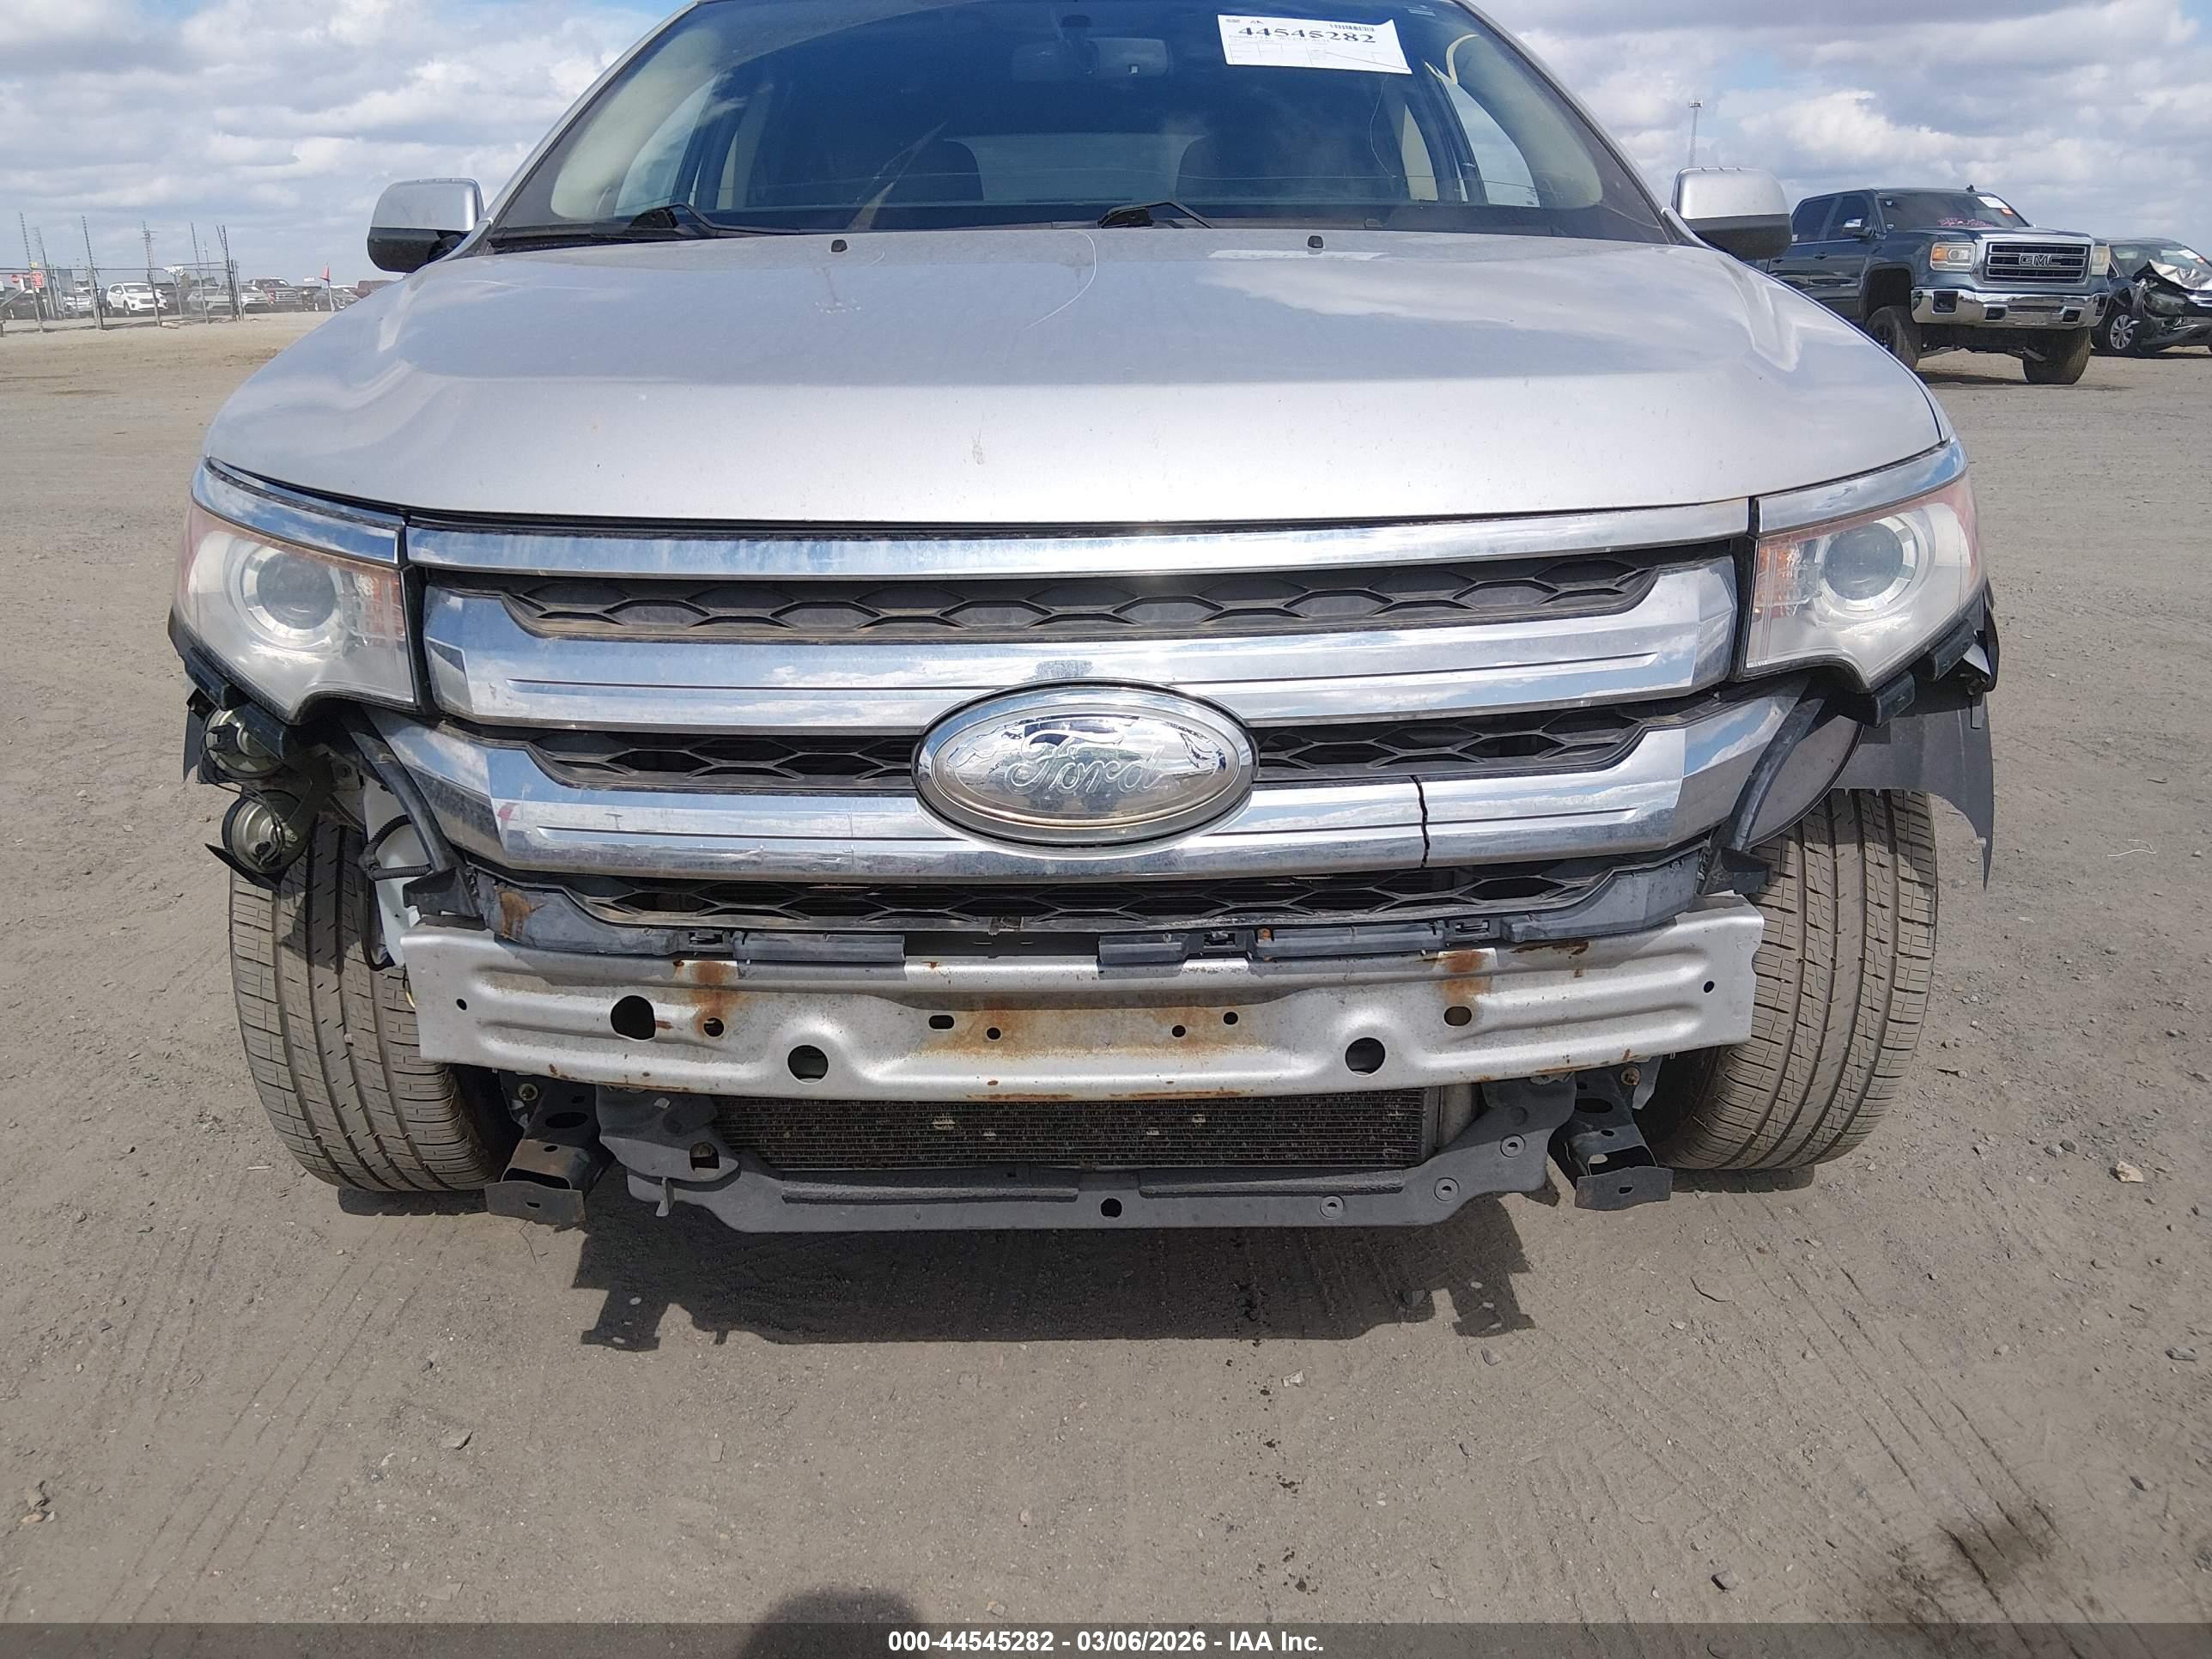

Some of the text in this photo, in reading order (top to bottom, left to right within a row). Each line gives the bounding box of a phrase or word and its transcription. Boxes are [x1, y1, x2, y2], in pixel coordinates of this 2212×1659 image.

[1237, 27, 1376, 43] 44545282
[2018, 253, 2062, 267] GMC
[1005, 729, 1166, 794] Ford
